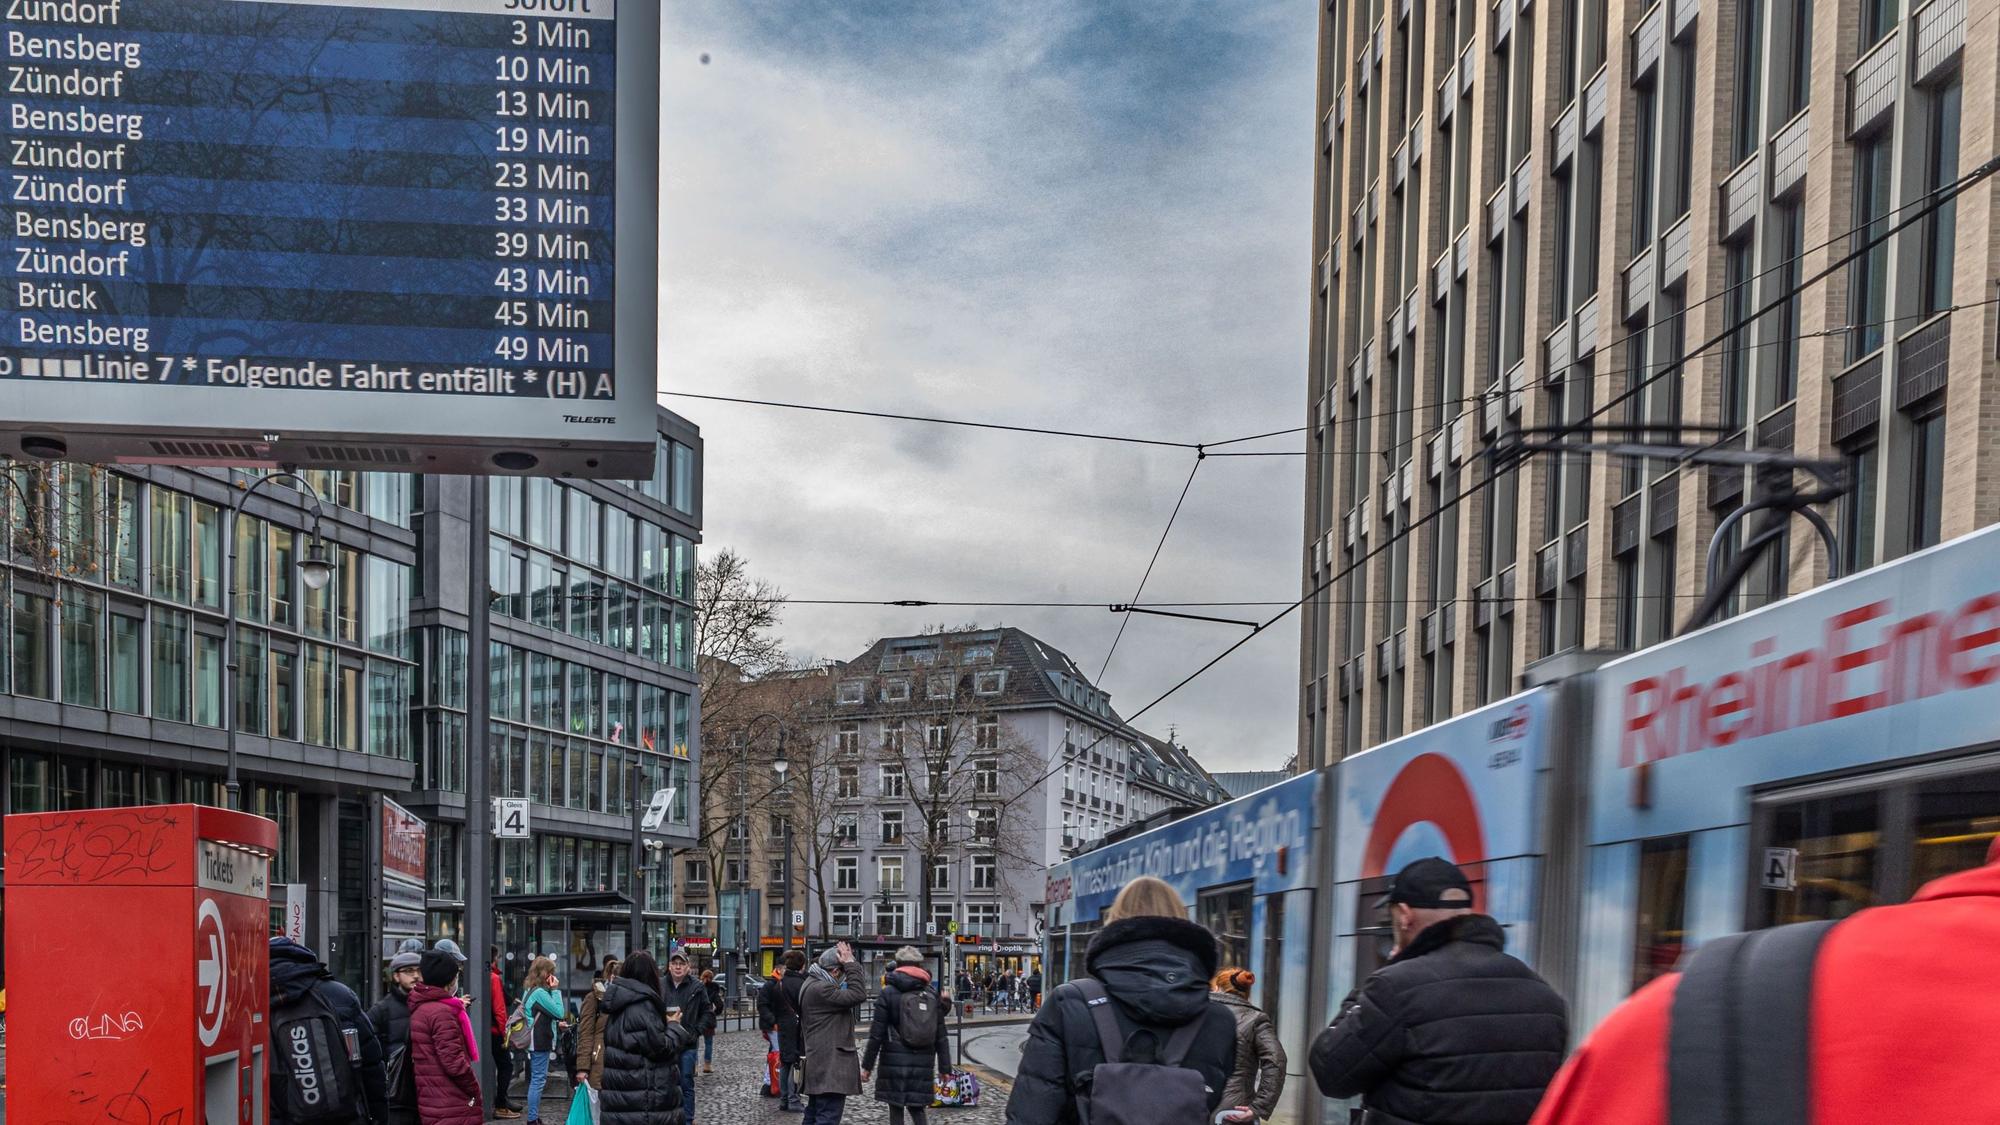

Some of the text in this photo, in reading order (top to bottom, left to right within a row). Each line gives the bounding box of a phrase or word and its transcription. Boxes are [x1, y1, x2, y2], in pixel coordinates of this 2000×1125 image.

[511, 19, 528, 45] 3
[538, 21, 590, 48] Min
[8, 30, 590, 85] Bensberg 10 Min
[8, 66, 590, 119] Zündorf 13 Min
[11, 103, 590, 155] Bensberg 19 Min
[10, 139, 590, 191] Zündorf 23 Min
[12, 174, 590, 225] Zündorf 33 Min
[15, 211, 590, 260] Bensberg 39 Min
[15, 247, 590, 295] Zündorf 43 Min
[18, 281, 590, 328] Brück 45 Min
[19, 317, 590, 363] Bensberg 49 Min
[84, 354, 149, 380] Linie
[155, 356, 174, 382] 7
[207, 358, 332, 389] Folgende
[340, 363, 412, 390] Fahrt
[418, 366, 516, 393] entfällt
[546, 369, 587, 399] (H)
[593, 373, 613, 396] A
[562, 414, 616, 424] TELESTE
[504, 810, 525, 834] 4
[506, 801, 523, 809] Gleis
[204, 850, 234, 884] Tickets
[1174, 826, 1202, 875] und
[331, 942, 337, 952] 2
[290, 1025, 321, 1105] adidas
